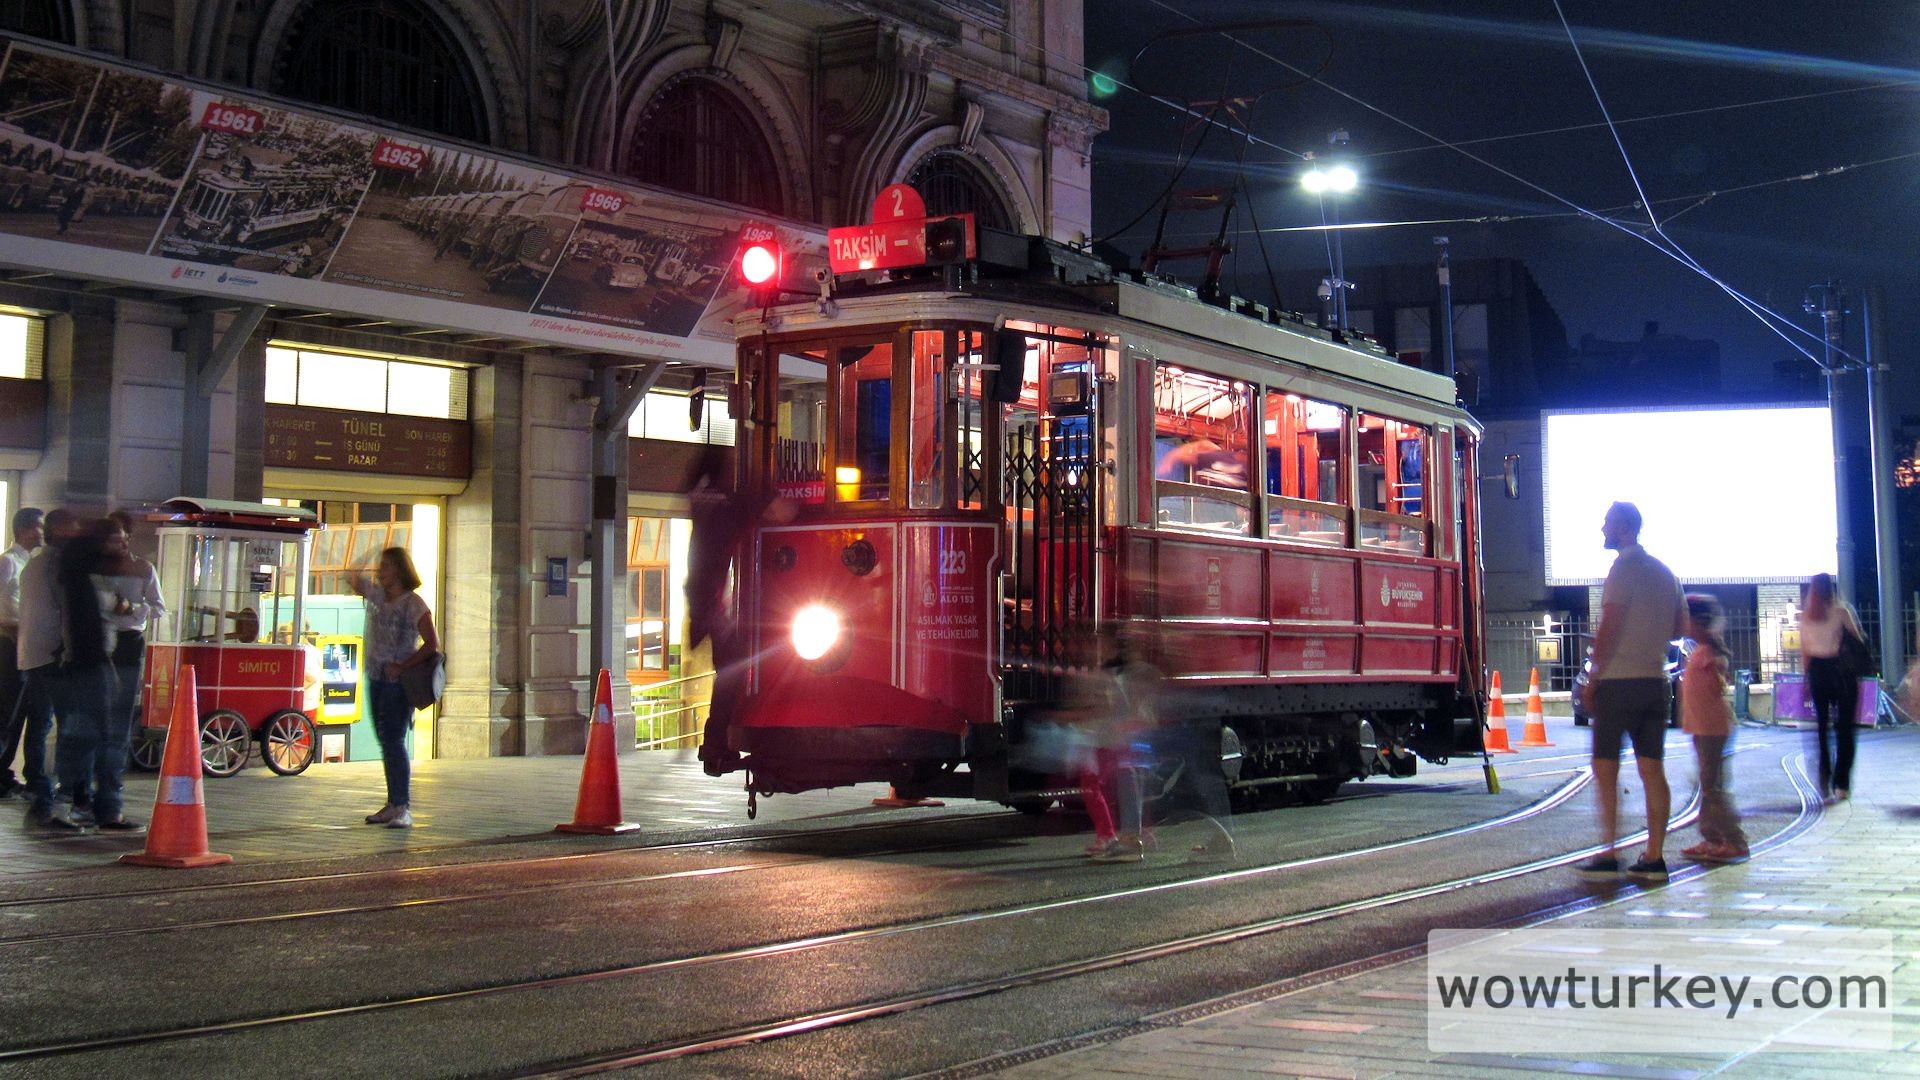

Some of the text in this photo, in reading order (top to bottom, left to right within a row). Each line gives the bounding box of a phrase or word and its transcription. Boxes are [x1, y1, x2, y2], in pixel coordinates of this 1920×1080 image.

[208, 108, 257, 132] 1961
[378, 146, 422, 168] 1962
[585, 192, 622, 211] 1966
[891, 188, 904, 217] 2
[834, 230, 887, 260] TAKSİM
[342, 417, 386, 437] TÜNEL
[348, 454, 378, 466] PAZAR
[941, 550, 966, 575] 223
[940, 594, 958, 603] ALO
[960, 595, 975, 604] 153
[917, 615, 977, 625] ASILMAK YASAK
[916, 627, 979, 640] VE TEHLİKELİDİR
[238, 660, 281, 675] SİMİTÇİ
